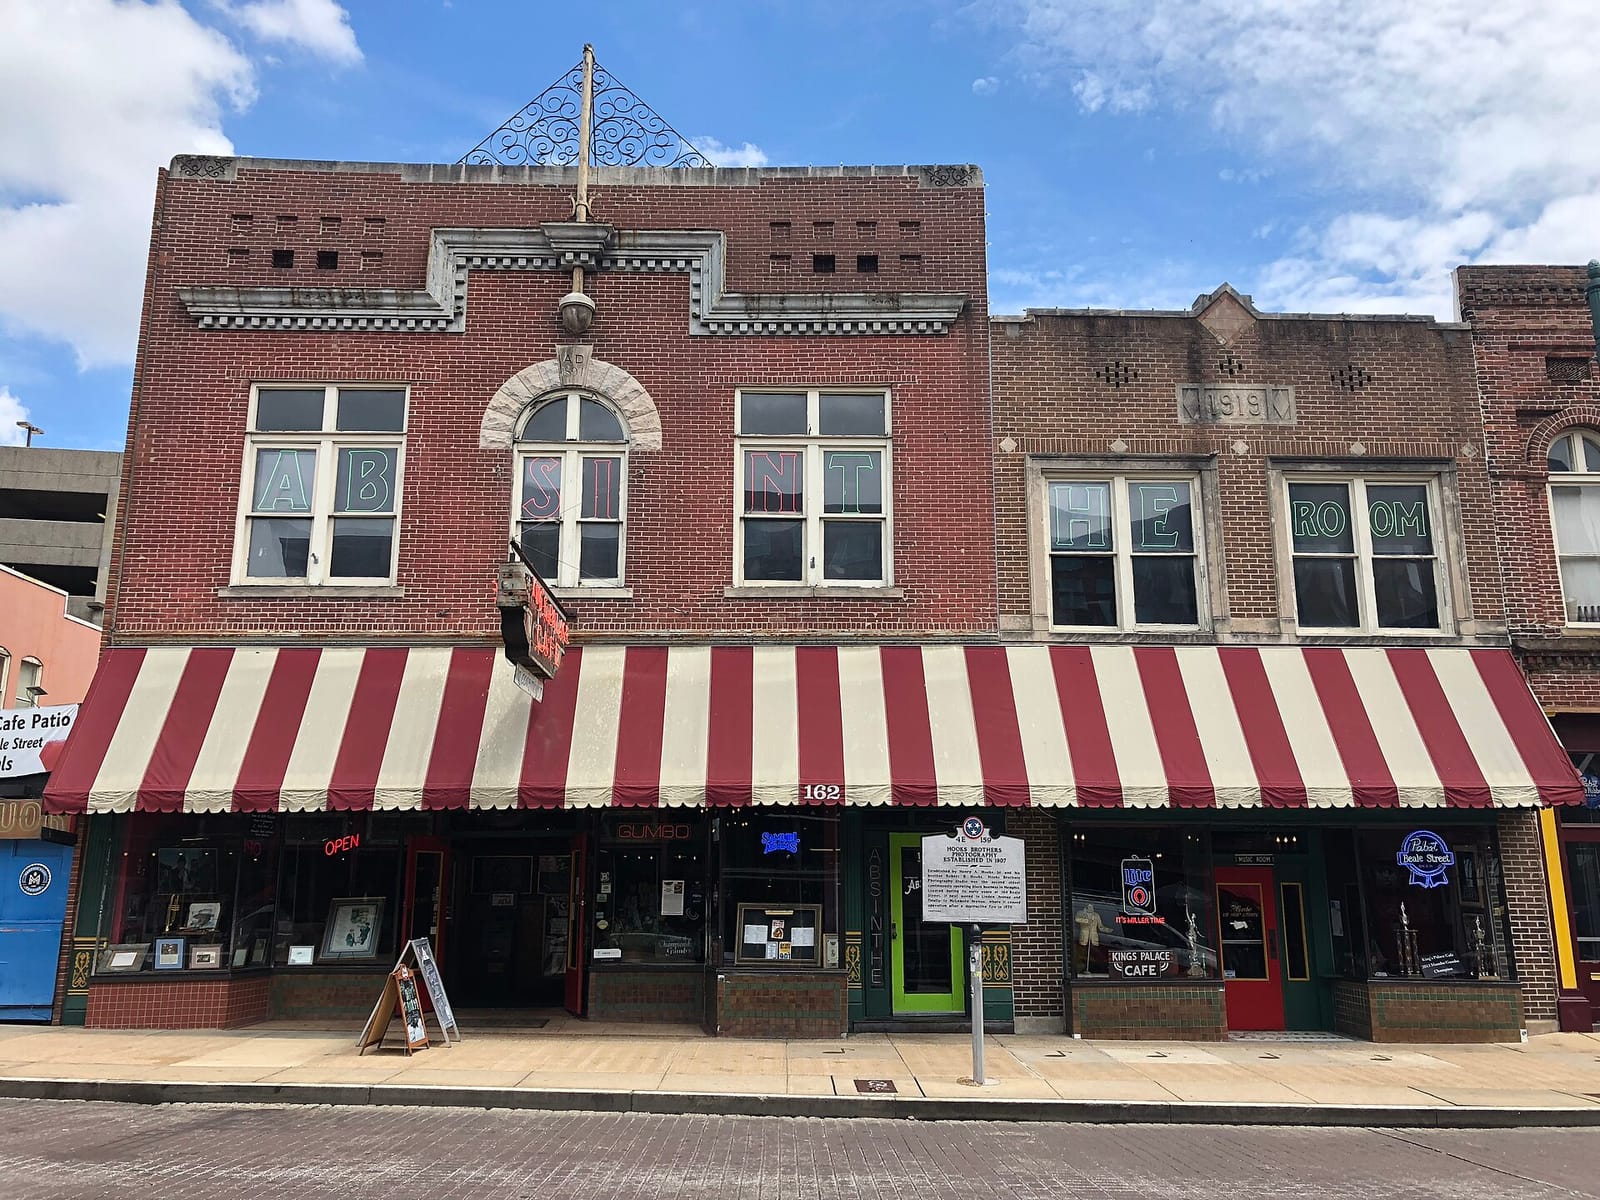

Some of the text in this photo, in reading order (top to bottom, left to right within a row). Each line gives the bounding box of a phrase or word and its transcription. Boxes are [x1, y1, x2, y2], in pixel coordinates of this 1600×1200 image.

[1206, 393, 1261, 417] 1919
[31, 711, 71, 729] Patio
[12, 736, 44, 750] Street
[803, 784, 841, 800] 162
[617, 824, 691, 839] GUMBO
[324, 833, 360, 856] OPEN
[1409, 837, 1439, 852] Pabst
[1403, 853, 1451, 863] Beale Street
[1124, 868, 1152, 887] Lite
[869, 848, 884, 985] ABSINTHE
[1127, 917, 1150, 925] MILLER
[1111, 951, 1171, 962] KINGS PALACE
[1124, 964, 1157, 976] CAFE
